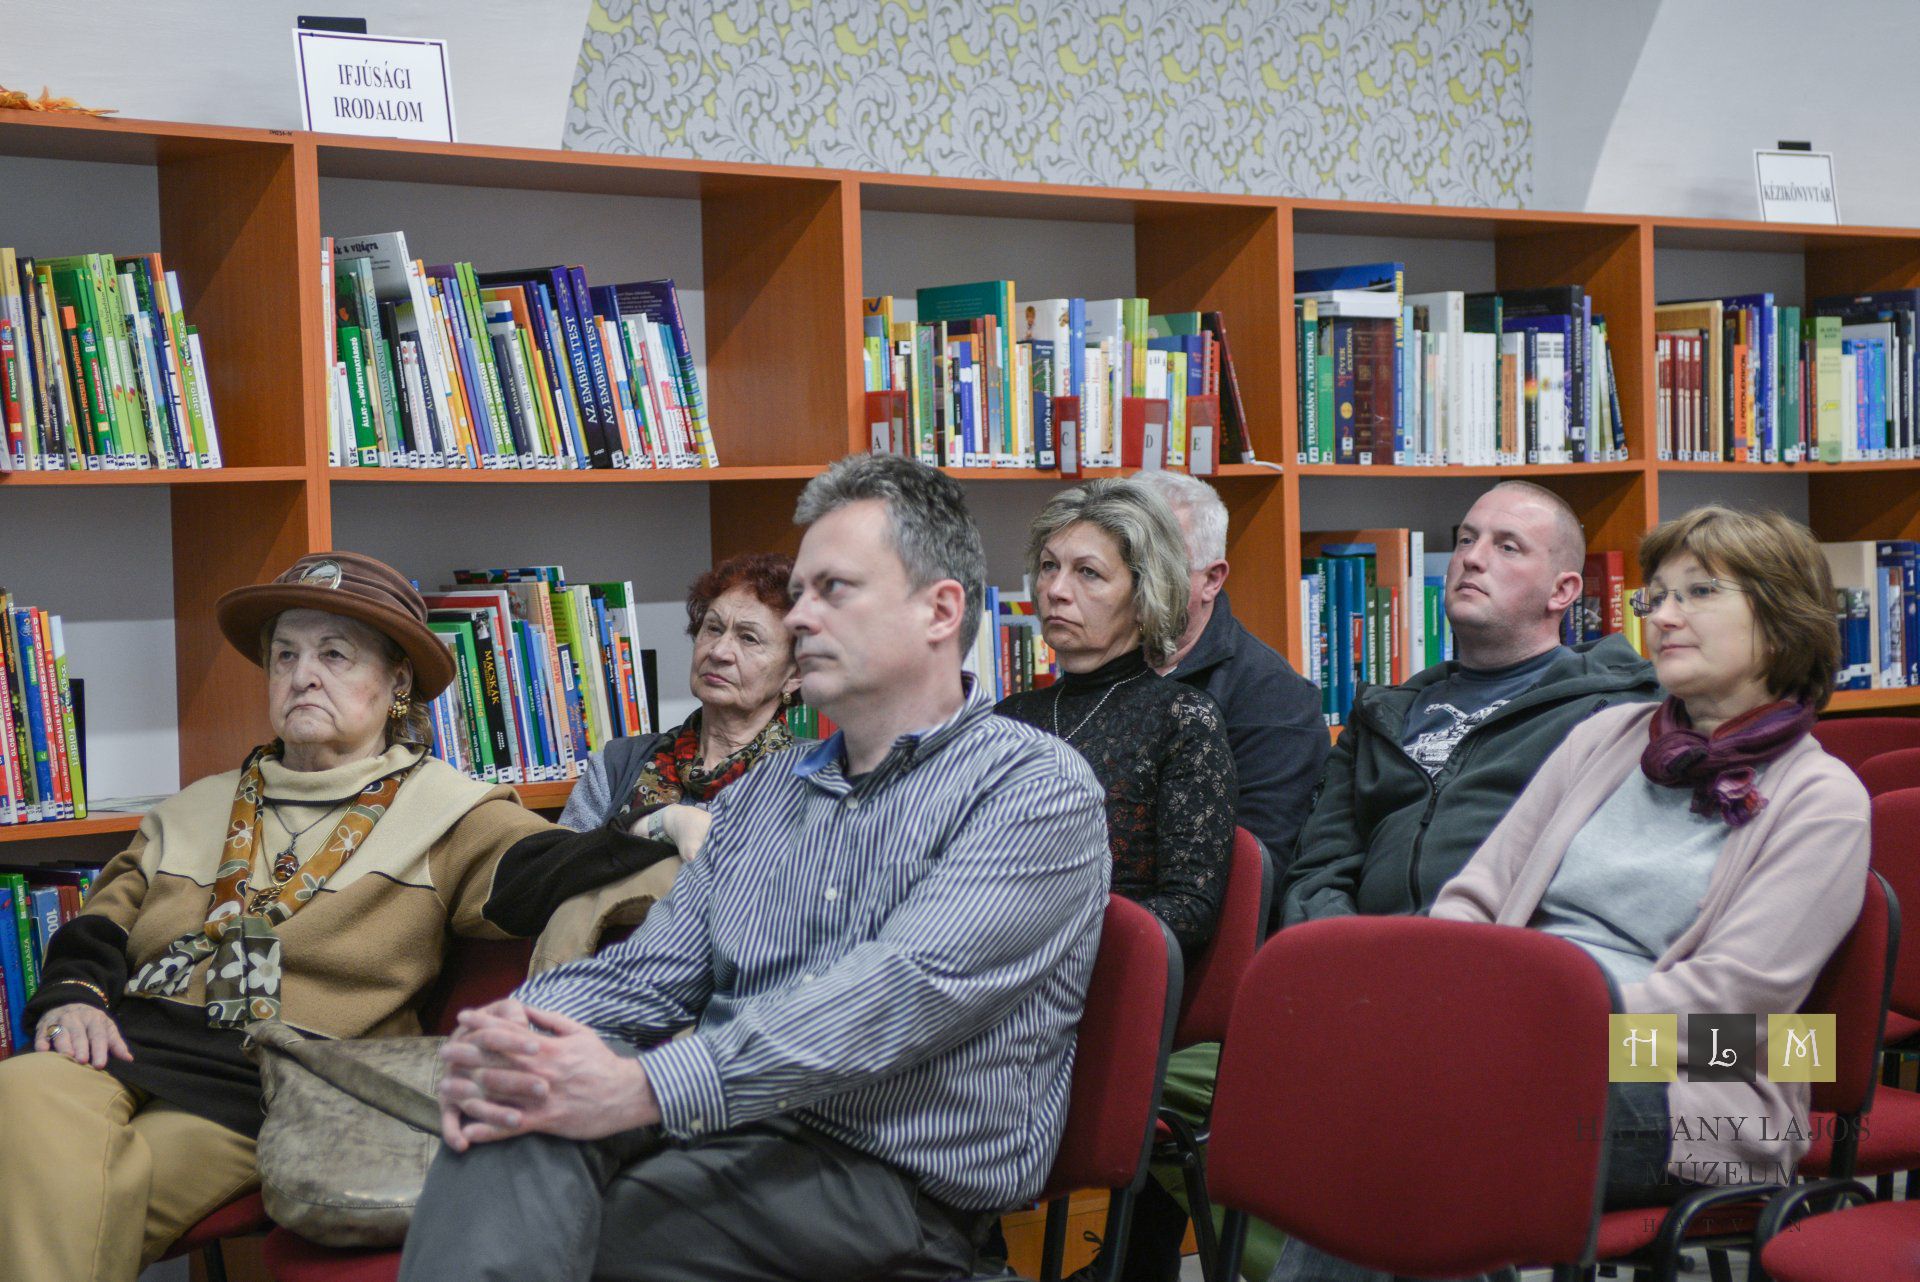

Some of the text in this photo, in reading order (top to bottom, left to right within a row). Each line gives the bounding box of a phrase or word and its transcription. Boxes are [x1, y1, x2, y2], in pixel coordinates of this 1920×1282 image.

[338, 59, 412, 90] IFJÚSÁGI
[334, 96, 424, 123] IRODALOM
[1763, 181, 1832, 203] KÉZIKÖNYVTÁR
[368, 288, 380, 329] ATLASZA
[349, 337, 365, 398] NÖVÉNYHATÁROZÓ
[565, 316, 598, 425] AZ EMBERI TEST
[584, 317, 616, 425] AZ EMBERI TEST
[1306, 331, 1315, 381] TECHNIKA
[479, 362, 494, 403] ROVAROK
[488, 362, 502, 403] ROVAROK
[508, 377, 521, 414] MADARAK
[360, 405, 370, 427] ÁLLAT-
[1305, 390, 1317, 445] TUDOMÁNY
[873, 435, 881, 449] A
[1061, 431, 1069, 446] C
[1145, 434, 1154, 449] D
[1193, 436, 1201, 450] E
[1610, 584, 1623, 627] fizika
[484, 650, 500, 704] MACSKÁK
[24, 938, 32, 971] ATLASZA
